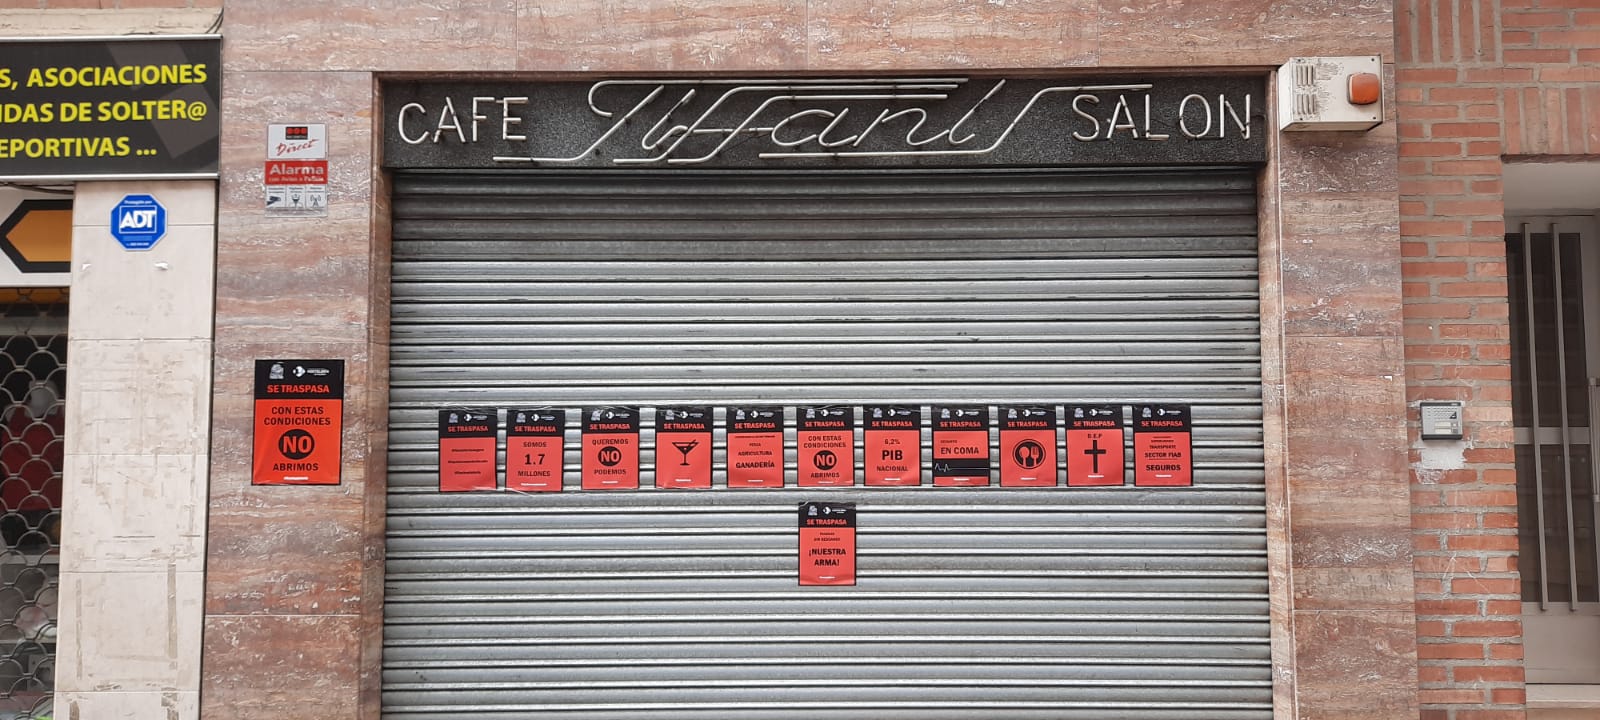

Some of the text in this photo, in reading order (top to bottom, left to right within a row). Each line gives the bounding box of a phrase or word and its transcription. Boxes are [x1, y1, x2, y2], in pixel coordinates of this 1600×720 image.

[27, 64, 207, 88] ASOCIACIONES
[60, 102, 91, 122] DE
[97, 99, 207, 122] SOLTER@
[398, 96, 528, 144] CAFE
[1072, 94, 1251, 141] SALON
[0, 137, 130, 158] EPORTIVAS
[276, 139, 319, 156] Direct
[269, 164, 324, 175] Alarma
[120, 210, 156, 228] ADT
[267, 384, 330, 393] SE TRASPASA
[271, 406, 324, 415] CON ESTAS
[264, 417, 331, 426] CONDICIONES
[448, 425, 489, 433] SE TRASPASA
[283, 435, 312, 454] NO
[882, 449, 903, 461] PIB
[940, 446, 979, 455] EN COMA
[524, 453, 546, 465] 1.7
[601, 451, 620, 462] NO
[816, 454, 835, 466] NO
[273, 463, 319, 472] ABRIMOS
[735, 461, 775, 469] GANADERÍA
[814, 559, 840, 567] ARMA!
